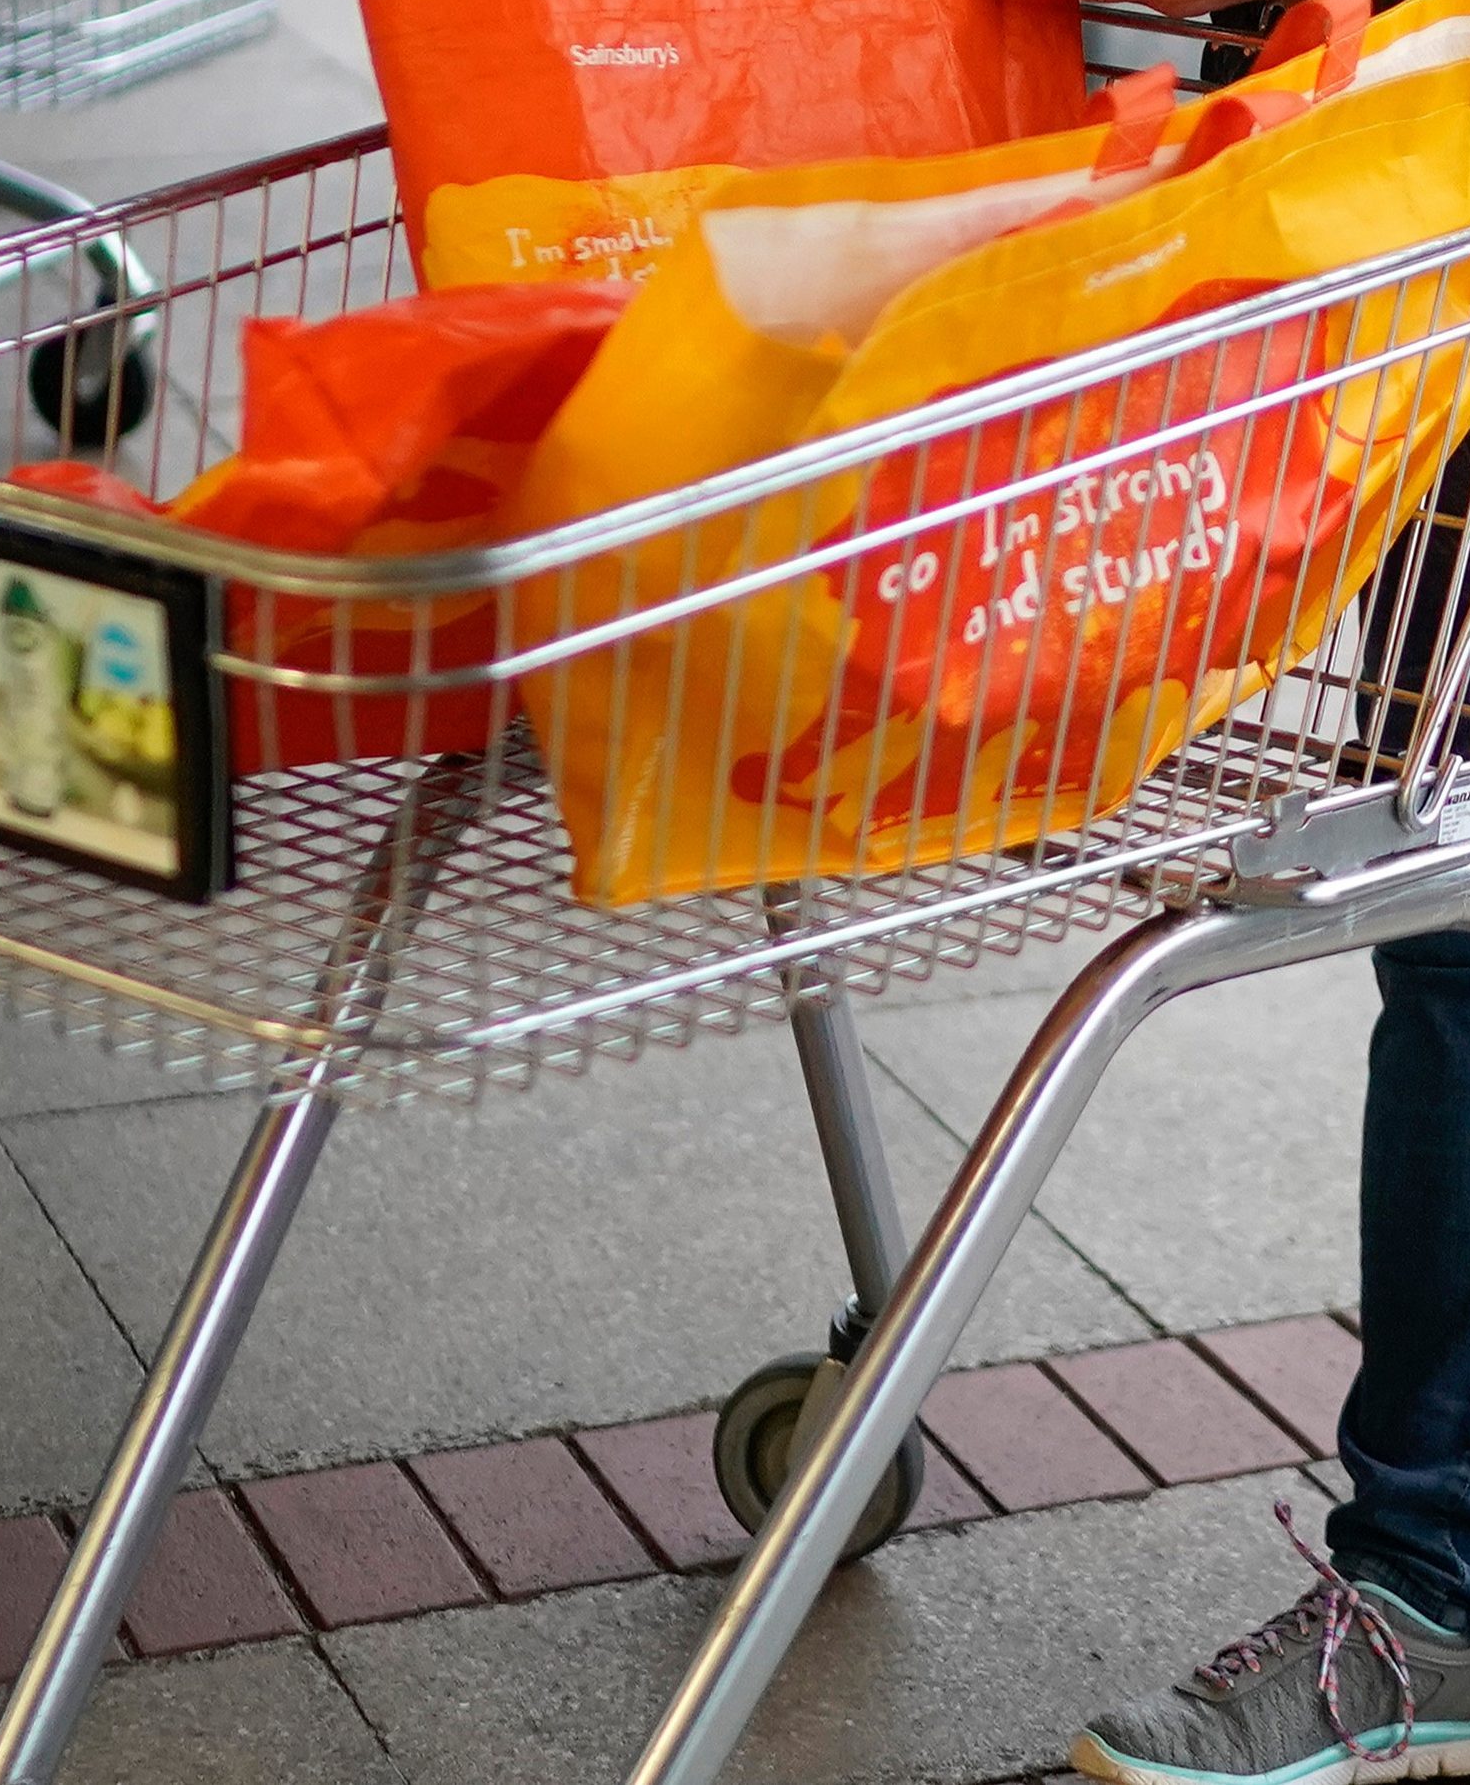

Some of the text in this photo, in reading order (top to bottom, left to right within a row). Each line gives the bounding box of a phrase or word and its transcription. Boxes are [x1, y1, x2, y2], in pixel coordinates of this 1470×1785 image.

[570, 42, 679, 69] Sainsbury's
[1053, 450, 1226, 535] strong
[963, 500, 1241, 644] and sturdy
